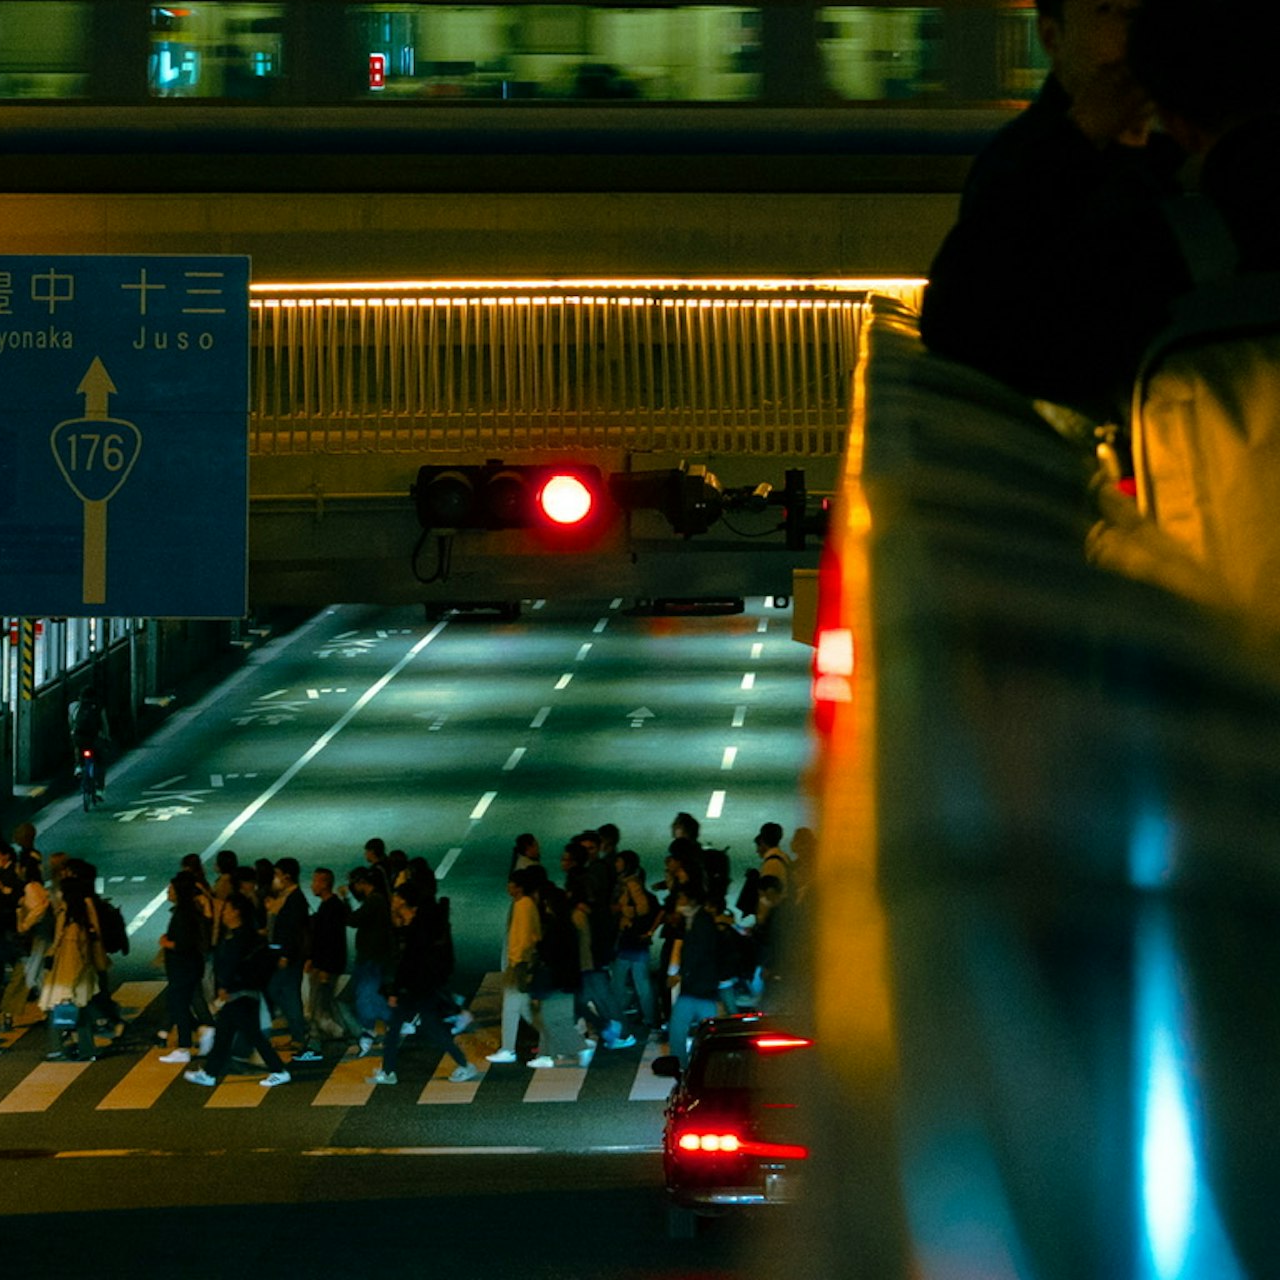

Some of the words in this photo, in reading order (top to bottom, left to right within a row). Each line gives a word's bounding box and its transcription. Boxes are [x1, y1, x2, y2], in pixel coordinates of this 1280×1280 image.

[121, 268, 226, 315] 十三
[132, 326, 215, 351] Juso
[66, 433, 125, 471] 176
